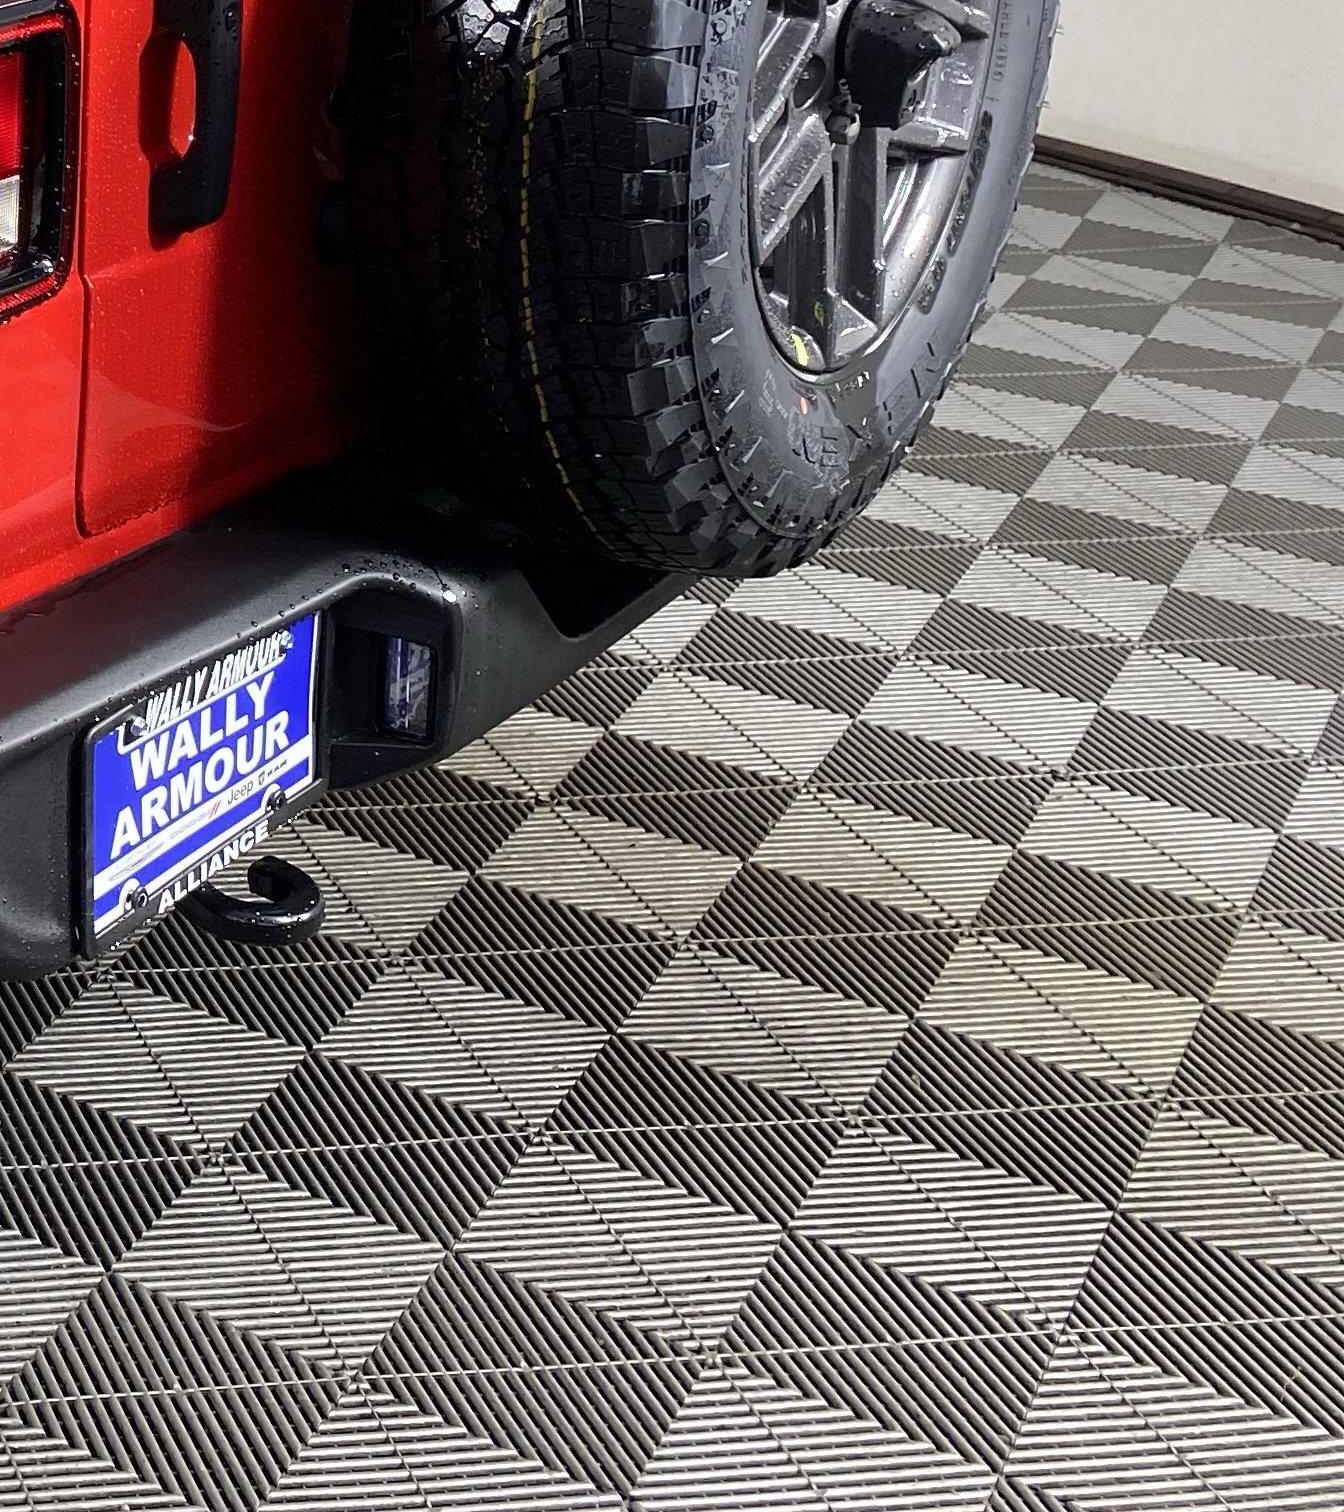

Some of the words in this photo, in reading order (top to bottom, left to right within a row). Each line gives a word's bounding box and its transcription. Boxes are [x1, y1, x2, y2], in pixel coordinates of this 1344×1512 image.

[130, 671, 275, 791] WALLY
[146, 666, 209, 734] WALLY
[110, 710, 290, 860] ARMOUR
[227, 780, 255, 806] Jeep
[158, 820, 269, 914] ALLIANCE
